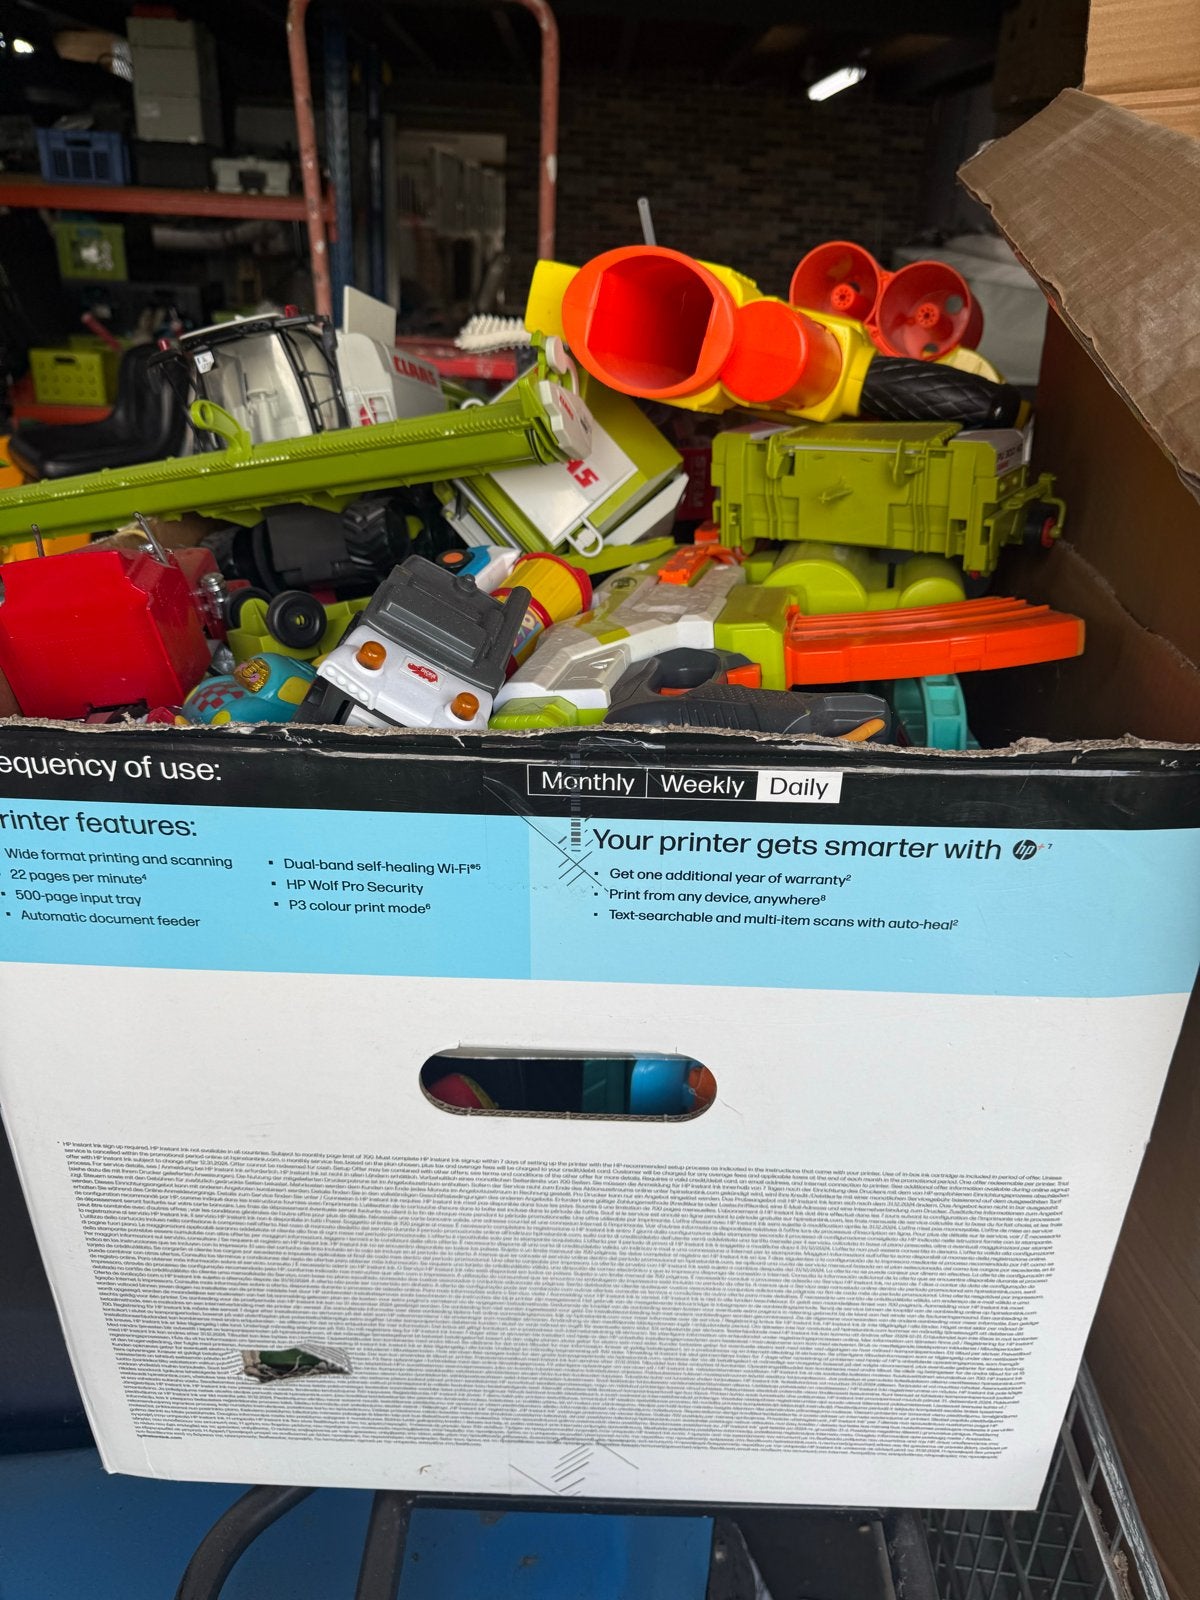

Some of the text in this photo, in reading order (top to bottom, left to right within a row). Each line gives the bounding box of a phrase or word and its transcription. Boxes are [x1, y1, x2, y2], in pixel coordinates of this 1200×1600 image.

[124, 755, 152, 779] of
[161, 760, 222, 781] use:
[541, 771, 636, 795] Monthly
[660, 774, 745, 798] Weekly
[770, 777, 829, 799] Daily
[76, 812, 197, 837] features:
[592, 828, 654, 851] Your
[659, 831, 751, 855] printer
[756, 834, 818, 859] gets
[824, 837, 939, 859] smarter
[943, 839, 1002, 860] with
[5, 847, 233, 869] Wide format printing and scanning
[283, 858, 354, 872] Dual-band
[357, 859, 435, 876] self-healing
[10, 869, 27, 880] 22
[29, 871, 70, 884] pages
[73, 872, 94, 885] per
[609, 868, 635, 881] Get
[637, 870, 663, 881] one
[665, 870, 733, 883] additional
[735, 873, 765, 885] year
[768, 872, 782, 884] of
[286, 879, 424, 896] HP Wolf Pro Security
[609, 889, 641, 901] Print
[643, 889, 675, 902] from
[677, 892, 702, 904] any
[704, 892, 751, 905] device,
[15, 889, 142, 906] 500-page input tray
[289, 900, 307, 911] P3
[309, 900, 352, 912] colour
[354, 902, 385, 916] print
[21, 909, 200, 927] Automatic document feeder
[609, 909, 713, 923] Text-searchable
[715, 912, 741, 924] and
[744, 913, 810, 926] multi-item
[813, 916, 854, 928] scans
[857, 917, 885, 929] with
